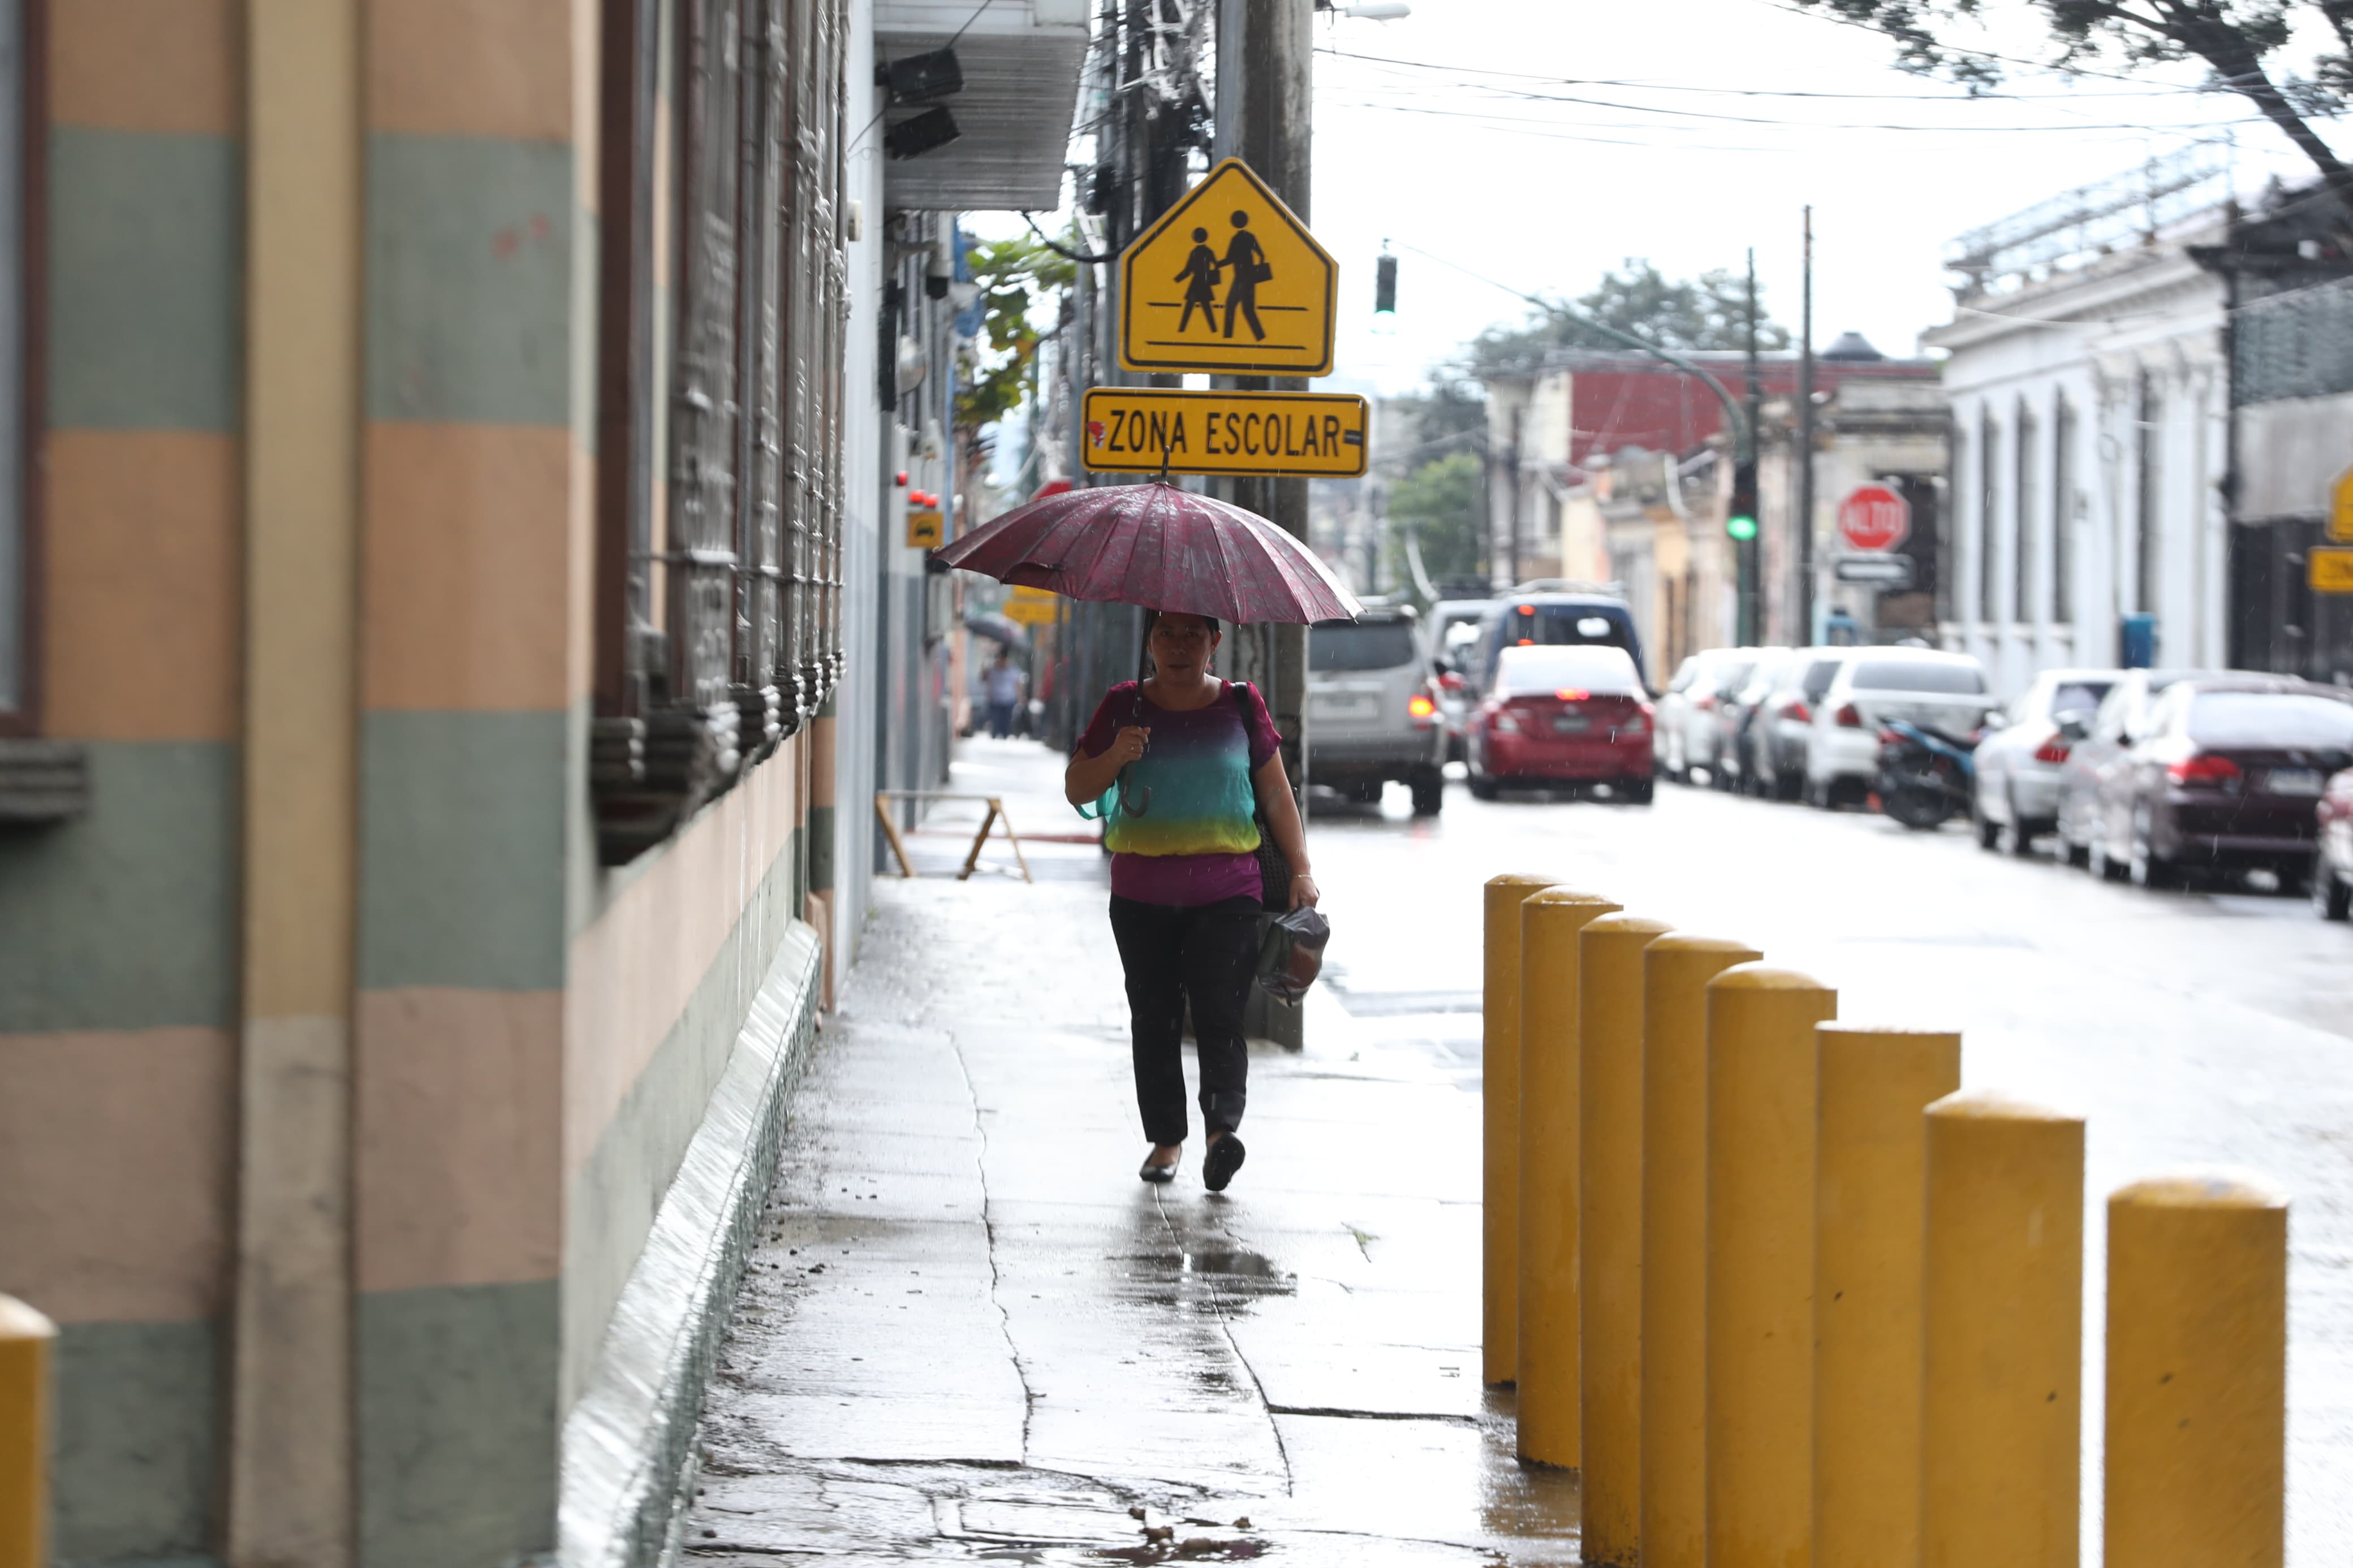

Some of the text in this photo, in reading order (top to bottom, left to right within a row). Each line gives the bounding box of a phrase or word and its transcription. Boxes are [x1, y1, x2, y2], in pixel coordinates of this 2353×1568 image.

[1109, 410, 1341, 457] ZONA ESCOLAR
[1841, 500, 1903, 534] ALTO
